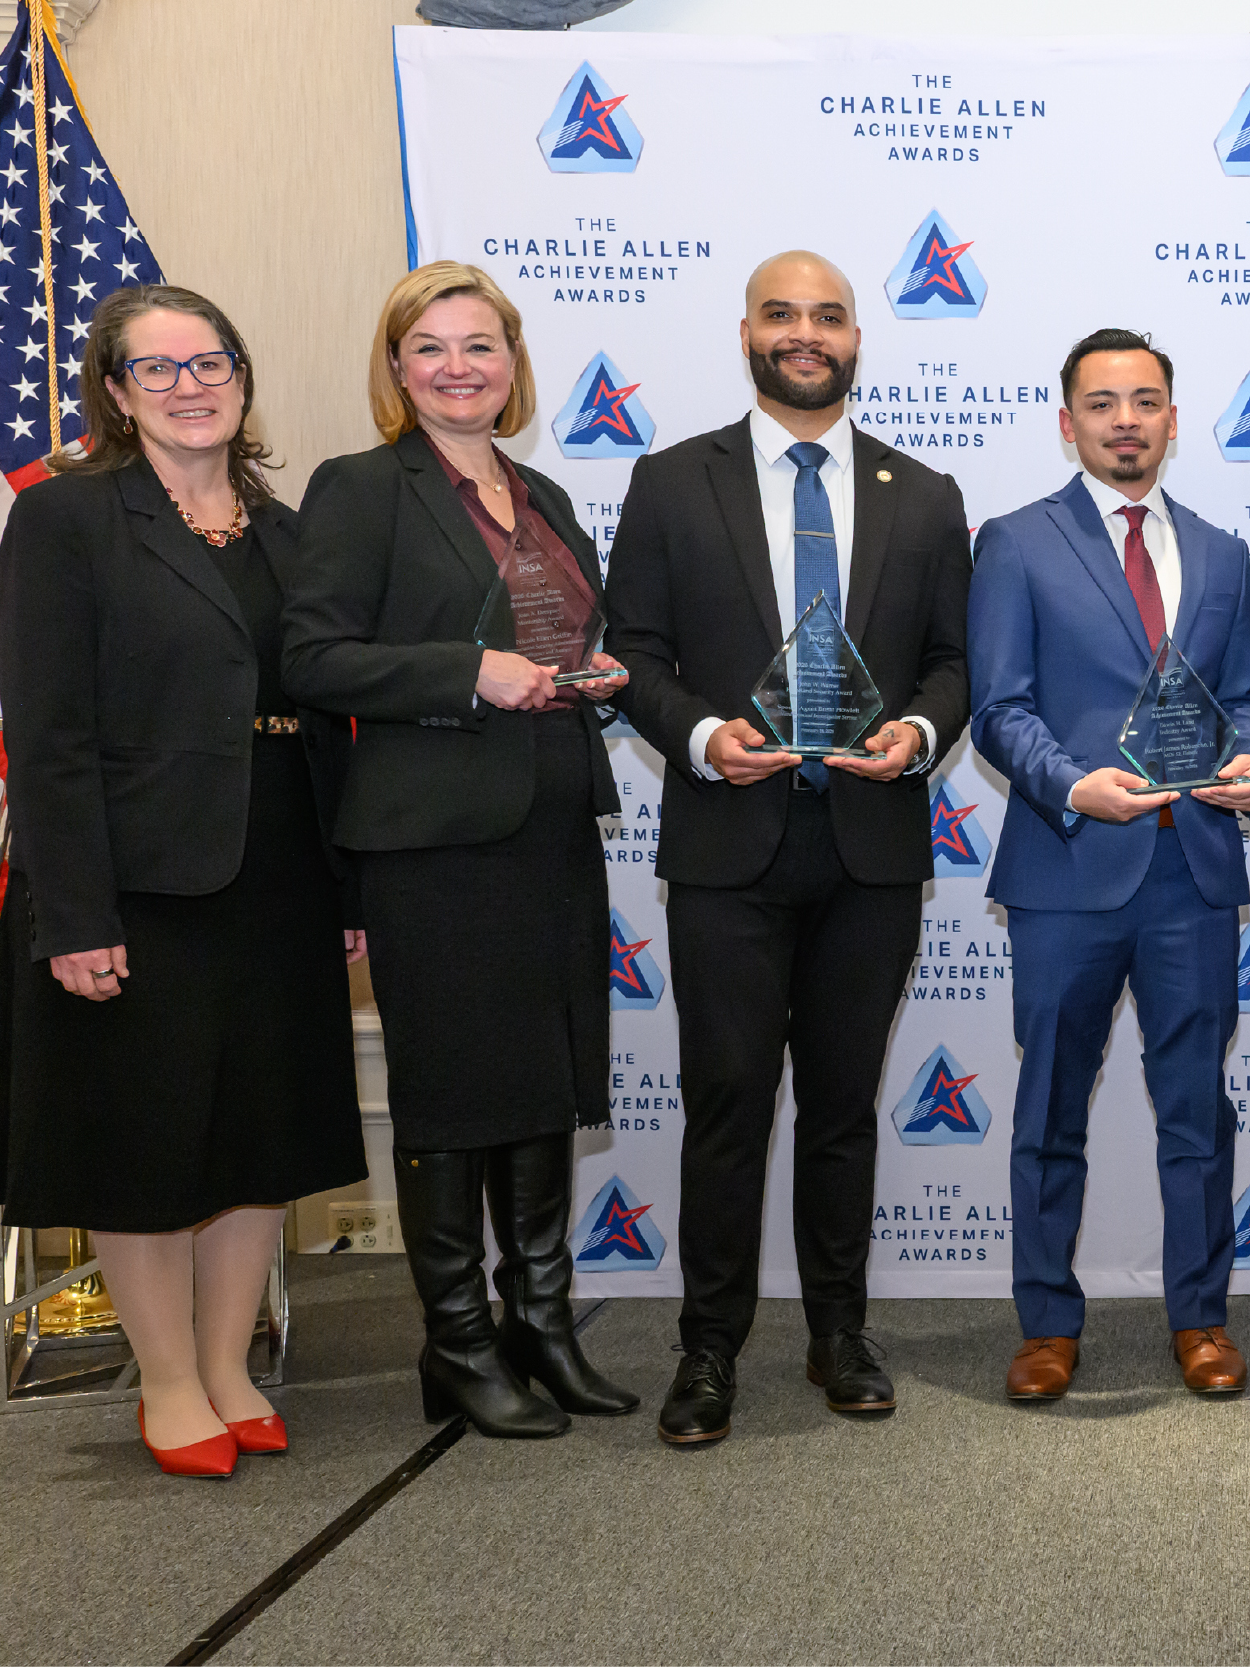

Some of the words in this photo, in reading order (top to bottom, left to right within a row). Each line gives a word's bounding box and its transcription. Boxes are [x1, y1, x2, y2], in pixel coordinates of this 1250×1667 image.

[912, 75, 951, 88] THE
[821, 97, 941, 114] CHARLIE
[958, 100, 1045, 117] ALLEN
[854, 123, 1013, 139] ACHIEVEMENT
[888, 147, 979, 161] AWARDS
[575, 218, 616, 231] THE
[484, 239, 606, 256] CHARLIE
[622, 240, 710, 257] ALLEN
[519, 265, 678, 280] ACHIEVEMENT
[554, 289, 645, 303] AWARDS
[918, 363, 957, 376] THE
[849, 386, 947, 402] HARLIE
[962, 387, 1048, 402] ALLEN
[861, 412, 1016, 424] ACHIEVEMENT
[894, 434, 984, 447] AWARDS
[519, 563, 543, 573] INSA
[810, 634, 833, 644] INSA
[1161, 678, 1183, 687] INSA
[604, 850, 657, 863] ARDS
[923, 920, 961, 932] THE
[966, 942, 1012, 957] ALL
[912, 966, 1012, 978] IEVEMEN
[611, 1053, 634, 1064] HE
[923, 1185, 961, 1197] THE
[874, 1206, 950, 1220] ARLIE
[966, 1206, 1012, 1220] ALL
[870, 1229, 1013, 1240] ACHIEVEMEN
[899, 1248, 986, 1260] AWARDS
